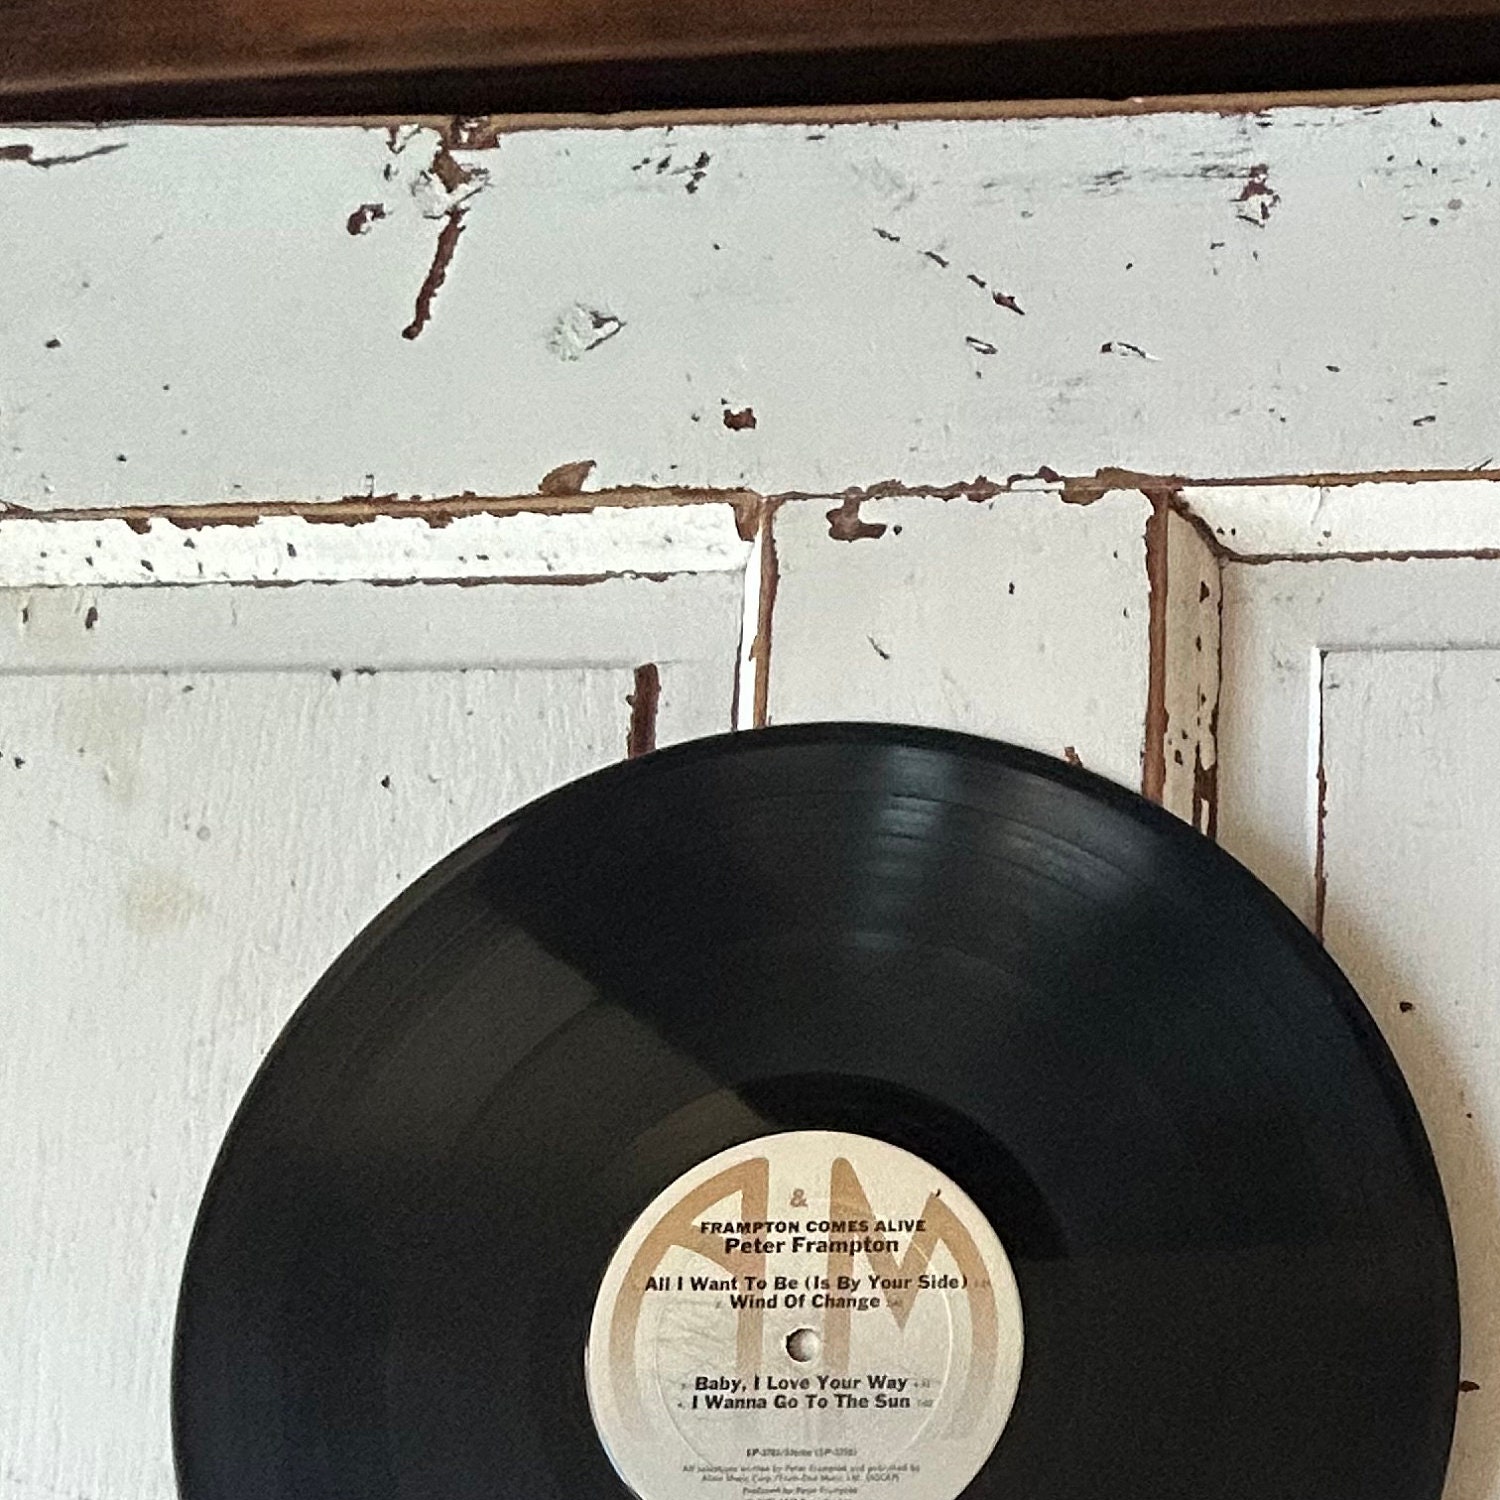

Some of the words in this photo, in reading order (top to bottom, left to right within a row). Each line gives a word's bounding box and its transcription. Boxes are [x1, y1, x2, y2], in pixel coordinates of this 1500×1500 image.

[789, 1188, 809, 1208] &
[701, 1221, 800, 1234] FRAMPTON
[806, 1220, 869, 1233] COMES
[874, 1220, 927, 1232] ALIVE
[724, 1238, 786, 1254] Peter
[791, 1236, 899, 1255] Frampton
[645, 1276, 670, 1291] All
[677, 1276, 683, 1291] I
[690, 1276, 738, 1291] Want
[744, 1276, 767, 1290] To
[774, 1276, 798, 1290] Be
[805, 1275, 830, 1291] (Is
[837, 1276, 861, 1292] By
[868, 1275, 912, 1290] Your
[917, 1274, 968, 1289] Side)
[730, 1294, 778, 1309] Wind
[784, 1294, 806, 1308] Of
[811, 1293, 881, 1311] Change
[694, 1376, 747, 1393] Baby,
[753, 1375, 760, 1390] I
[767, 1376, 810, 1390] Love
[817, 1375, 862, 1390] Your
[867, 1375, 908, 1392] Way
[691, 1395, 698, 1409] I
[704, 1395, 767, 1409] Wanna
[774, 1395, 798, 1409] Go
[805, 1394, 828, 1409] To
[834, 1394, 869, 1409] The
[875, 1394, 911, 1409] Sun
